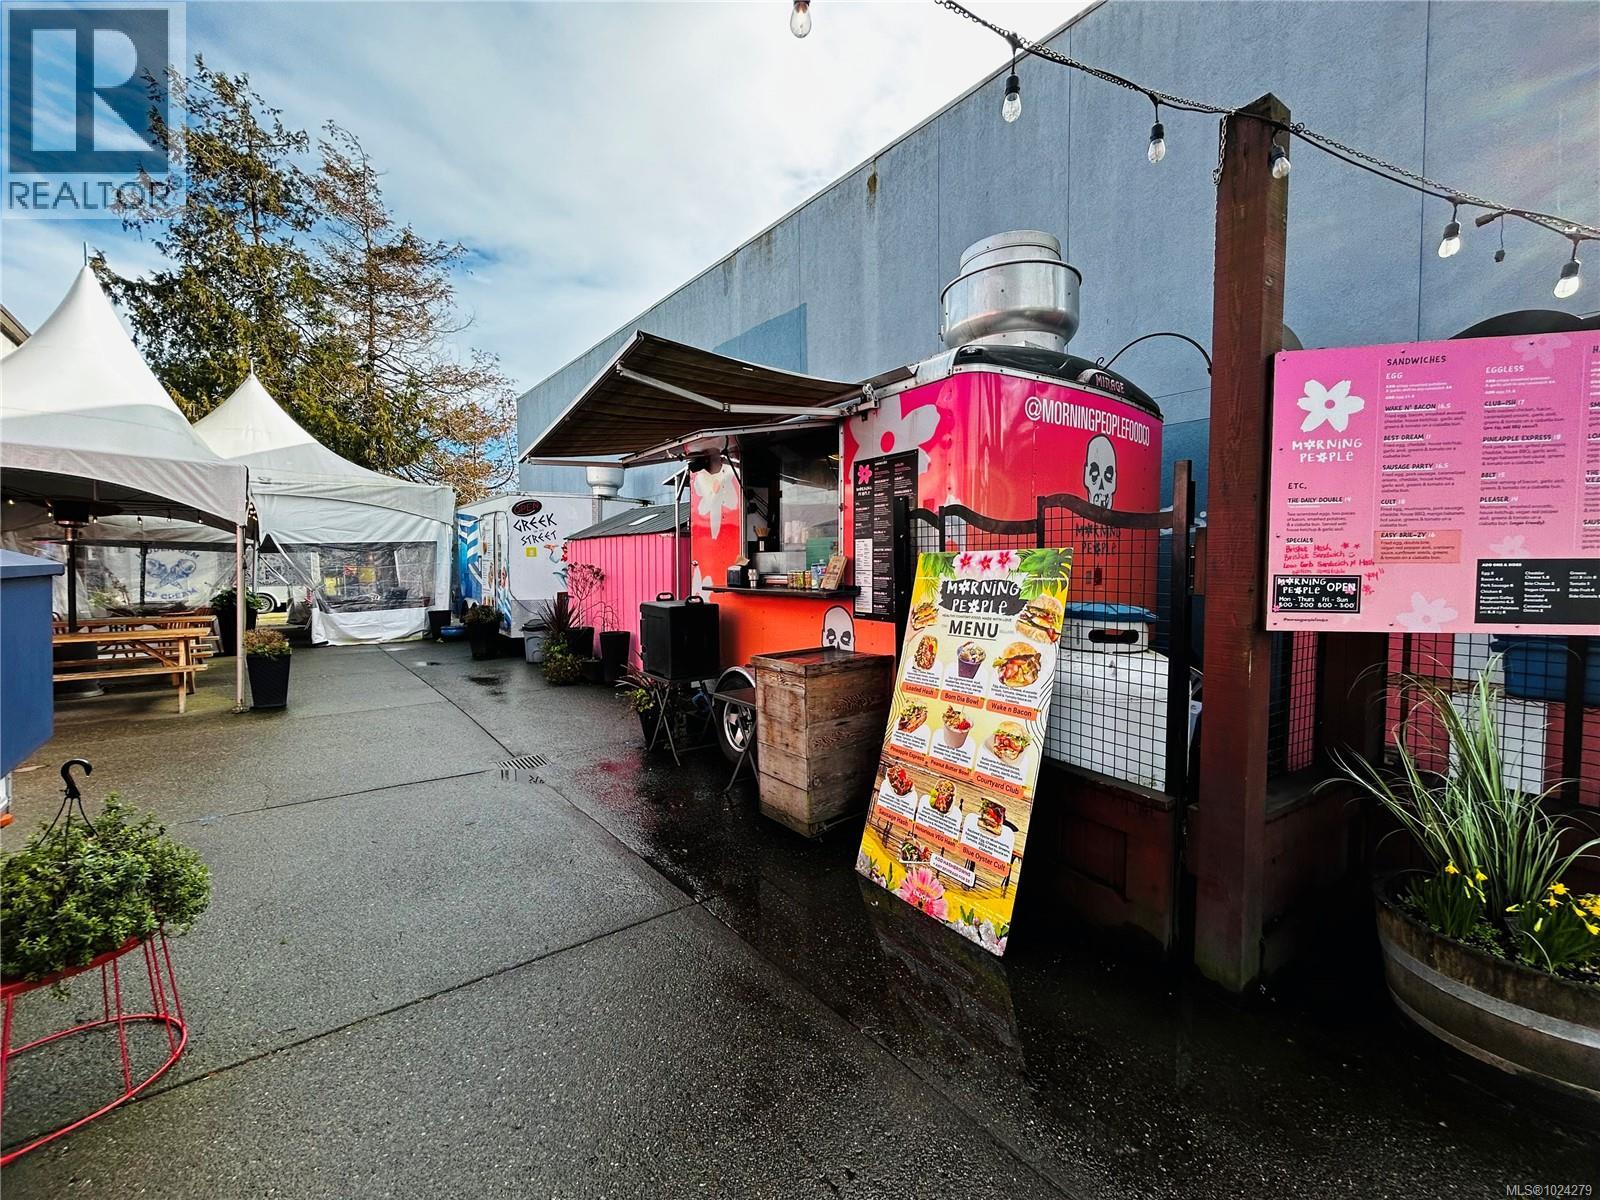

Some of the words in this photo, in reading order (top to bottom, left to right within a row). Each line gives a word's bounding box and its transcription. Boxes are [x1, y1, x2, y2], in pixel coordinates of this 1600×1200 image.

[1387, 355, 1447, 366] SANDWICHES
[1486, 365, 1524, 373] EGGLESS
[1095, 374, 1124, 393] MIRAGE
[1025, 396, 1149, 446] @MORNINGPEOPLEFOODCO
[1288, 482, 1307, 490] ETC.
[514, 503, 539, 513] OPEN
[513, 513, 557, 532] GREEK
[521, 530, 556, 546] STREET
[1327, 583, 1356, 592] OPEN
[949, 620, 999, 638] MENU
[906, 685, 921, 693] Loaded
[922, 688, 934, 696] Hash
[944, 691, 956, 700] Bom
[957, 694, 966, 702] Dia
[967, 696, 979, 705] Bowl
[991, 703, 1007, 711] Wake
[1013, 707, 1032, 717] Bacon
[890, 746, 908, 757] Pineapple
[909, 752, 925, 762] Express
[930, 760, 945, 768] Peanut
[945, 764, 959, 772] Butter
[960, 768, 970, 776] Bowl
[976, 775, 1004, 789] Courtyard
[1005, 785, 1019, 795] Club
[879, 808, 895, 821] Sausage
[896, 817, 908, 826] Hash
[944, 838, 956, 847] Hash
[962, 847, 975, 857] Blue
[975, 852, 993, 866] Oyster
[994, 860, 1006, 871] Cult
